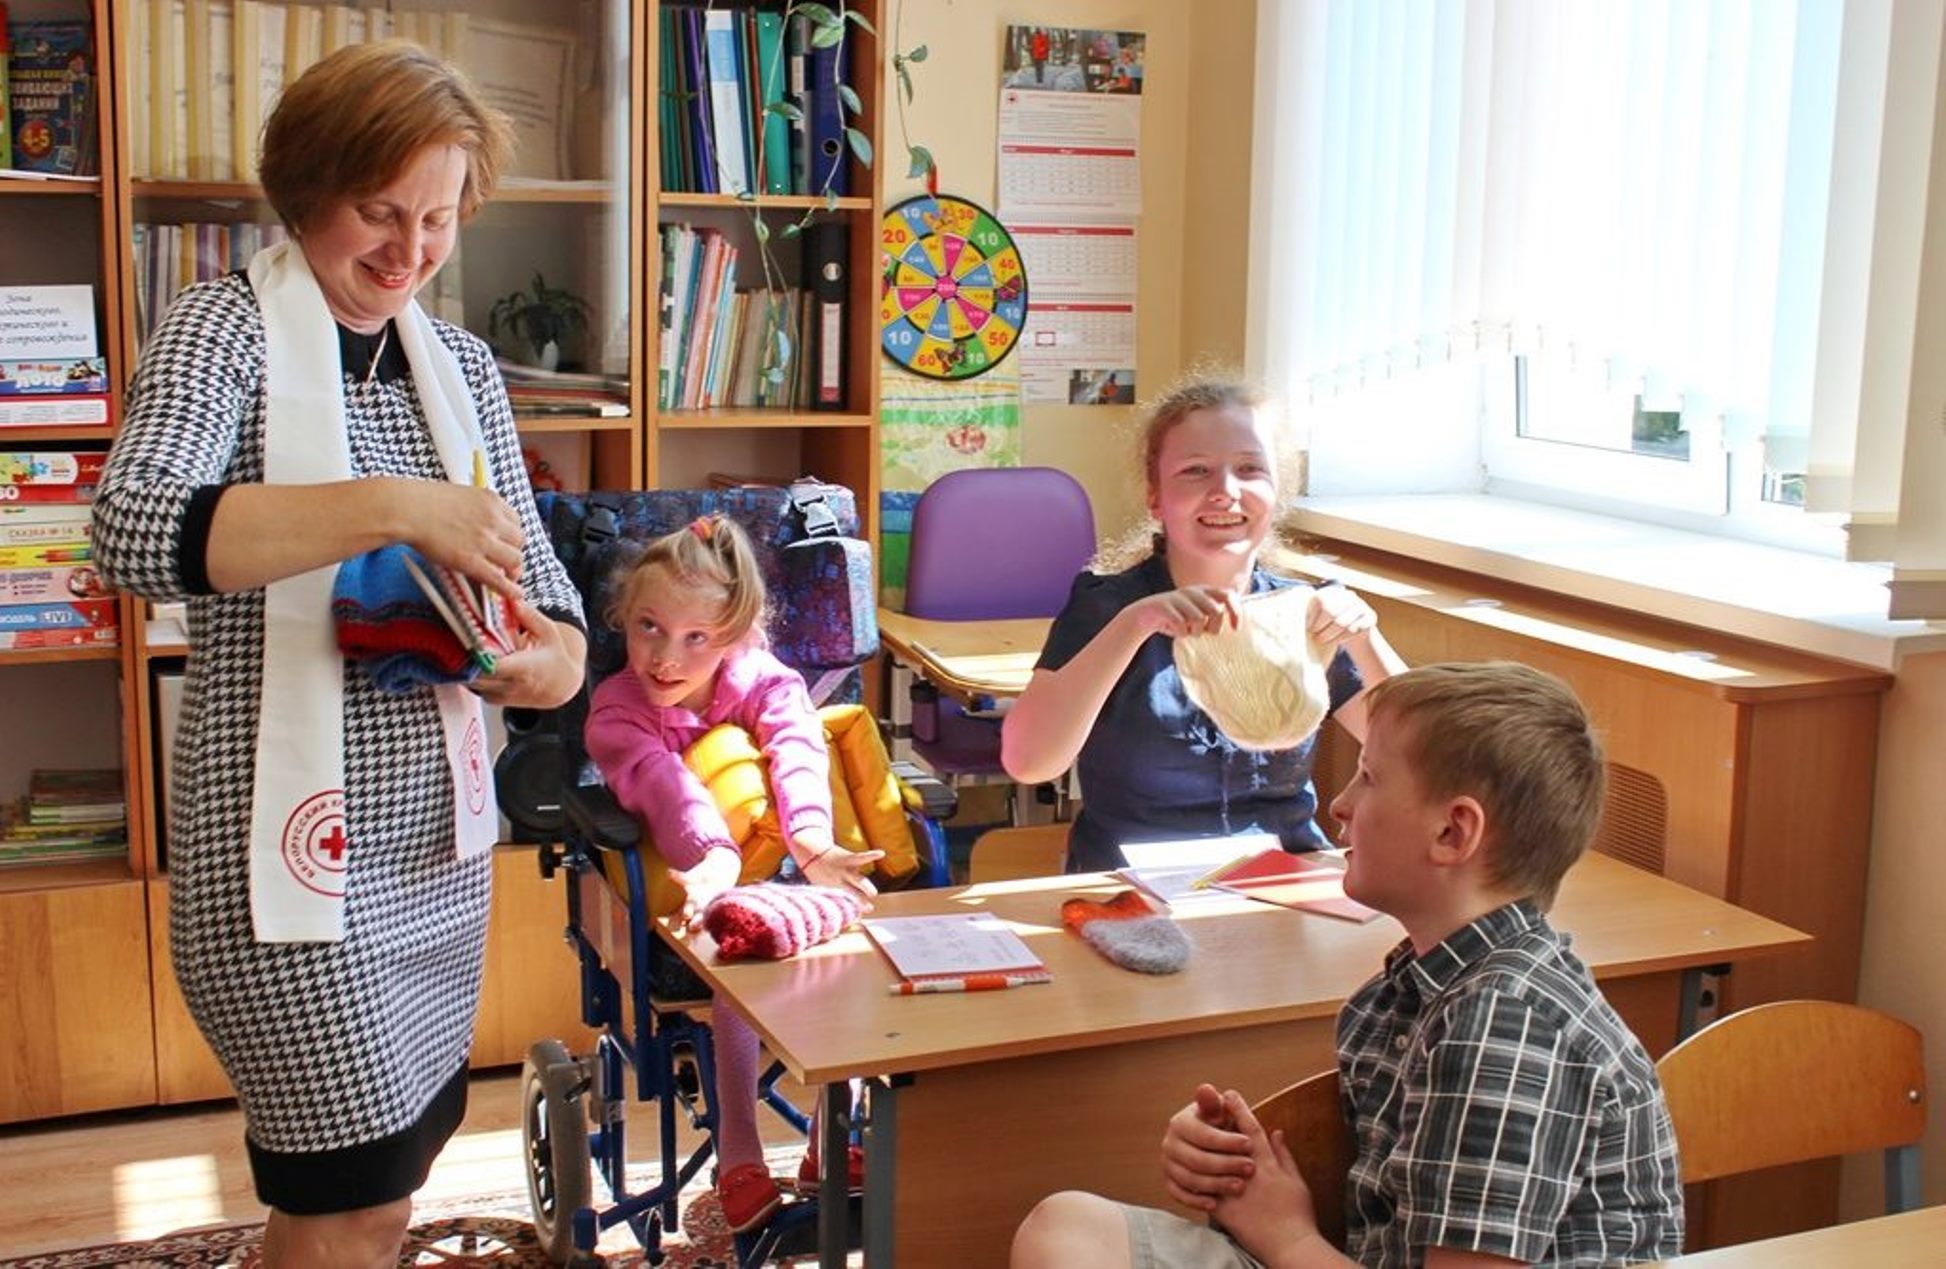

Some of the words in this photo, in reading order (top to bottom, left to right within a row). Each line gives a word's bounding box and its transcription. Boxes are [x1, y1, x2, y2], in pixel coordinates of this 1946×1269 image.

[902, 207, 921, 218] 10
[882, 229, 906, 244] 20
[977, 232, 998, 246] 10
[1000, 258, 1015, 270] 40
[1005, 307, 1020, 319] 10
[888, 331, 912, 345] 10
[988, 332, 1008, 346] 50
[917, 354, 935, 366] 60
[967, 352, 985, 364] 10
